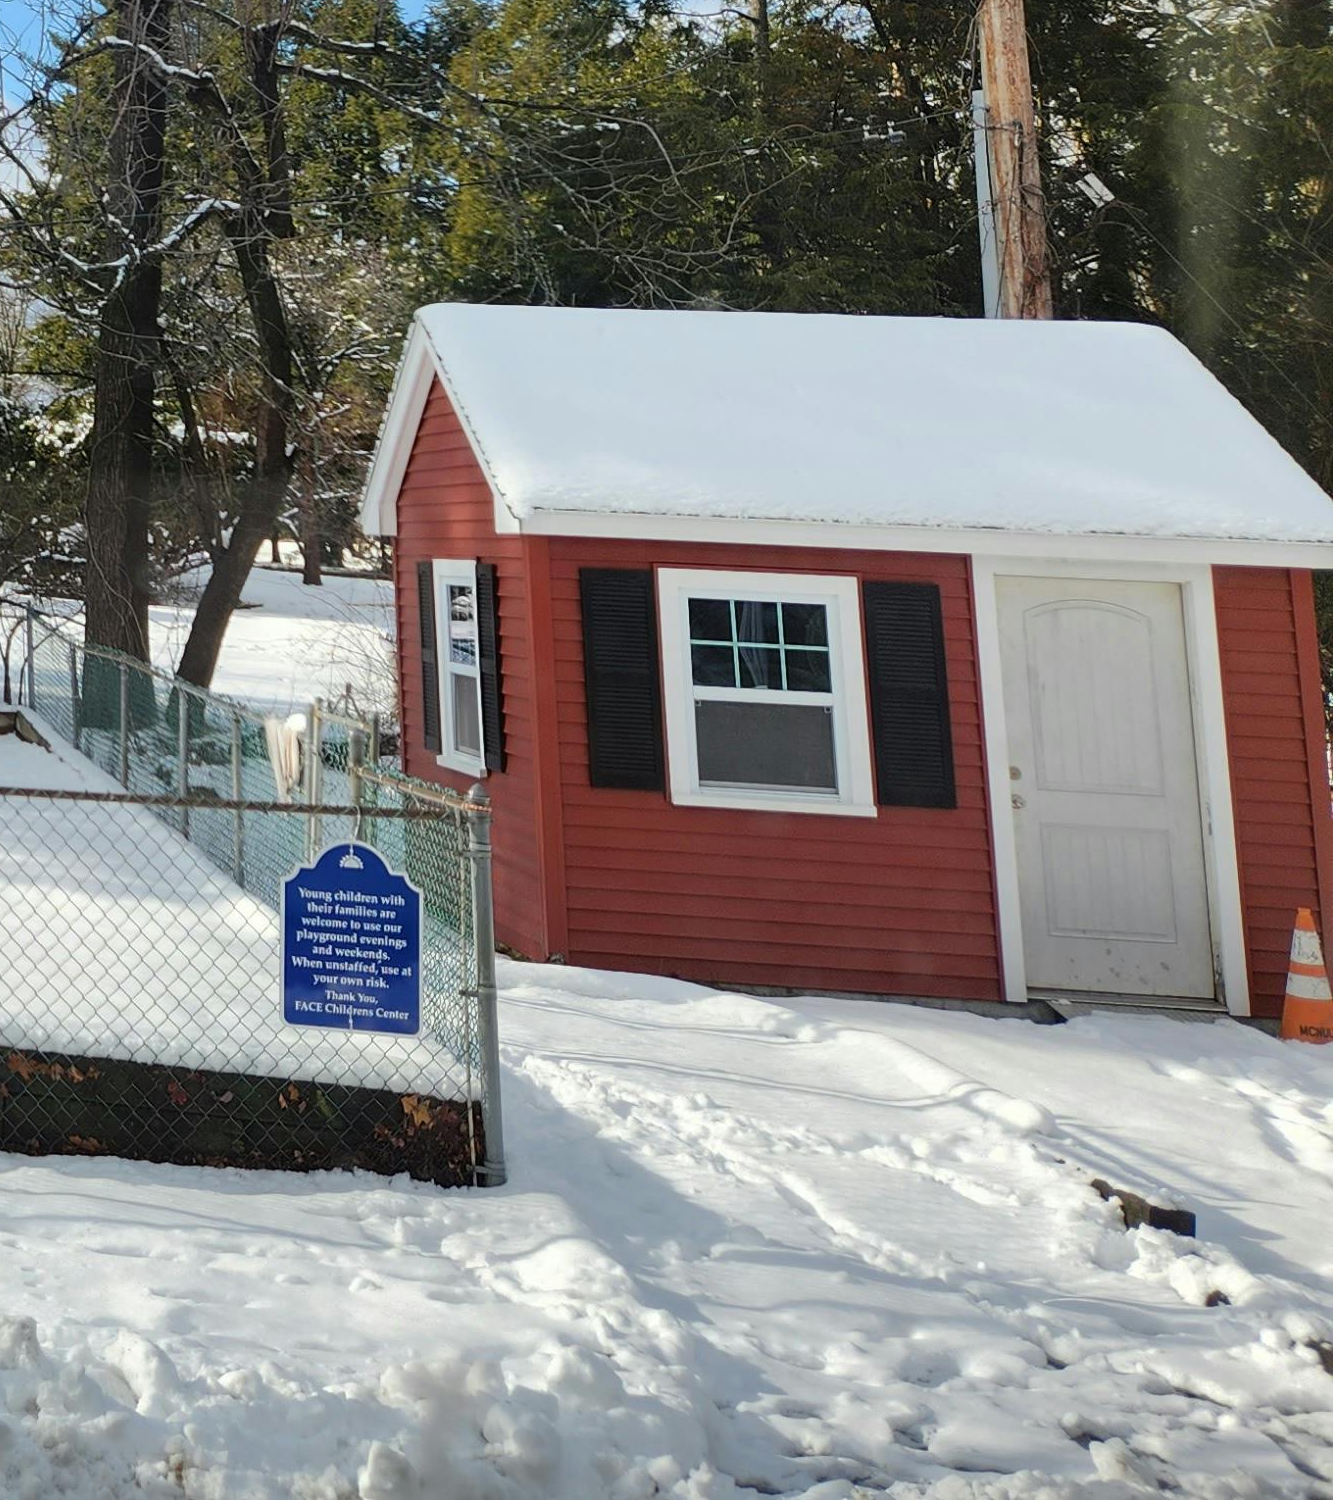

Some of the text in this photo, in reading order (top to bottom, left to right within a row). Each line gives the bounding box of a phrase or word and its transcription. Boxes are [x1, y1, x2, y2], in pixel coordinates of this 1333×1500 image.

[298, 886, 405, 906] Young children with
[307, 903, 396, 919] their families are
[302, 916, 402, 933] welcome to use our
[296, 930, 407, 950] playground evenings
[312, 945, 332, 956] and
[292, 956, 412, 976] When unstaffed, use at
[313, 975, 389, 988] your own risk.
[325, 990, 379, 1004] Thank You,
[295, 1001, 409, 1020] FACE Childrens Center
